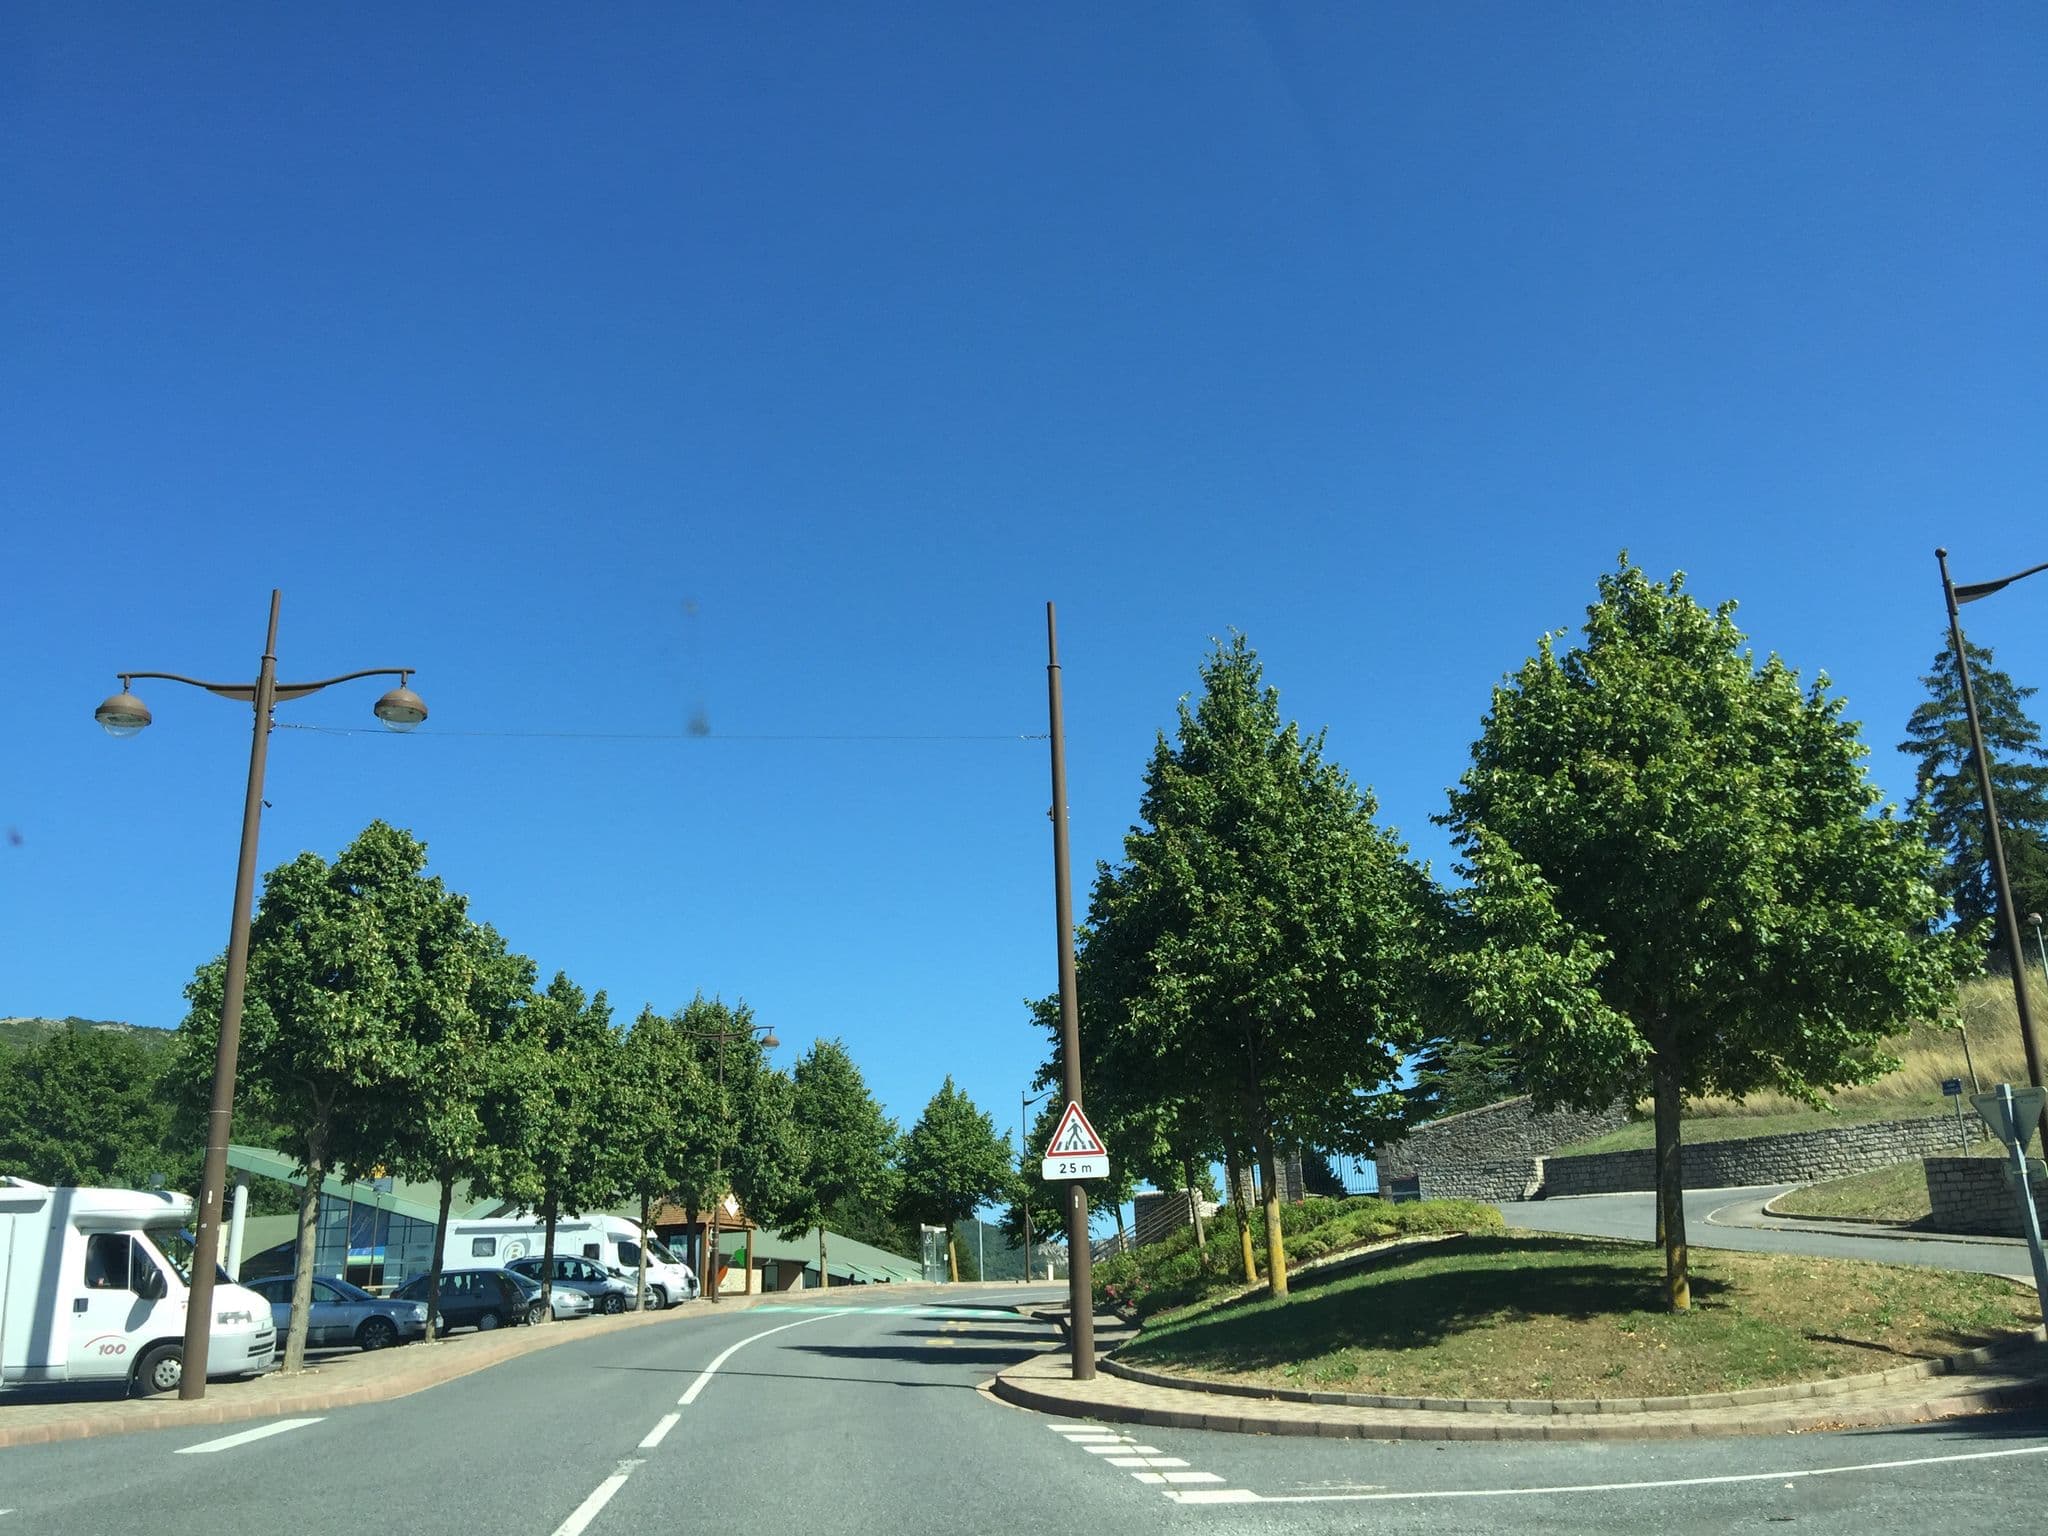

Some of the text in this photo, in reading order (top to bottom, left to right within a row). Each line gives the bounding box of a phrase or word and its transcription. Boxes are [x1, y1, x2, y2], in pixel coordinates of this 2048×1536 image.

[1059, 1163, 1092, 1174] 25 m
[98, 1344, 126, 1355] 100
